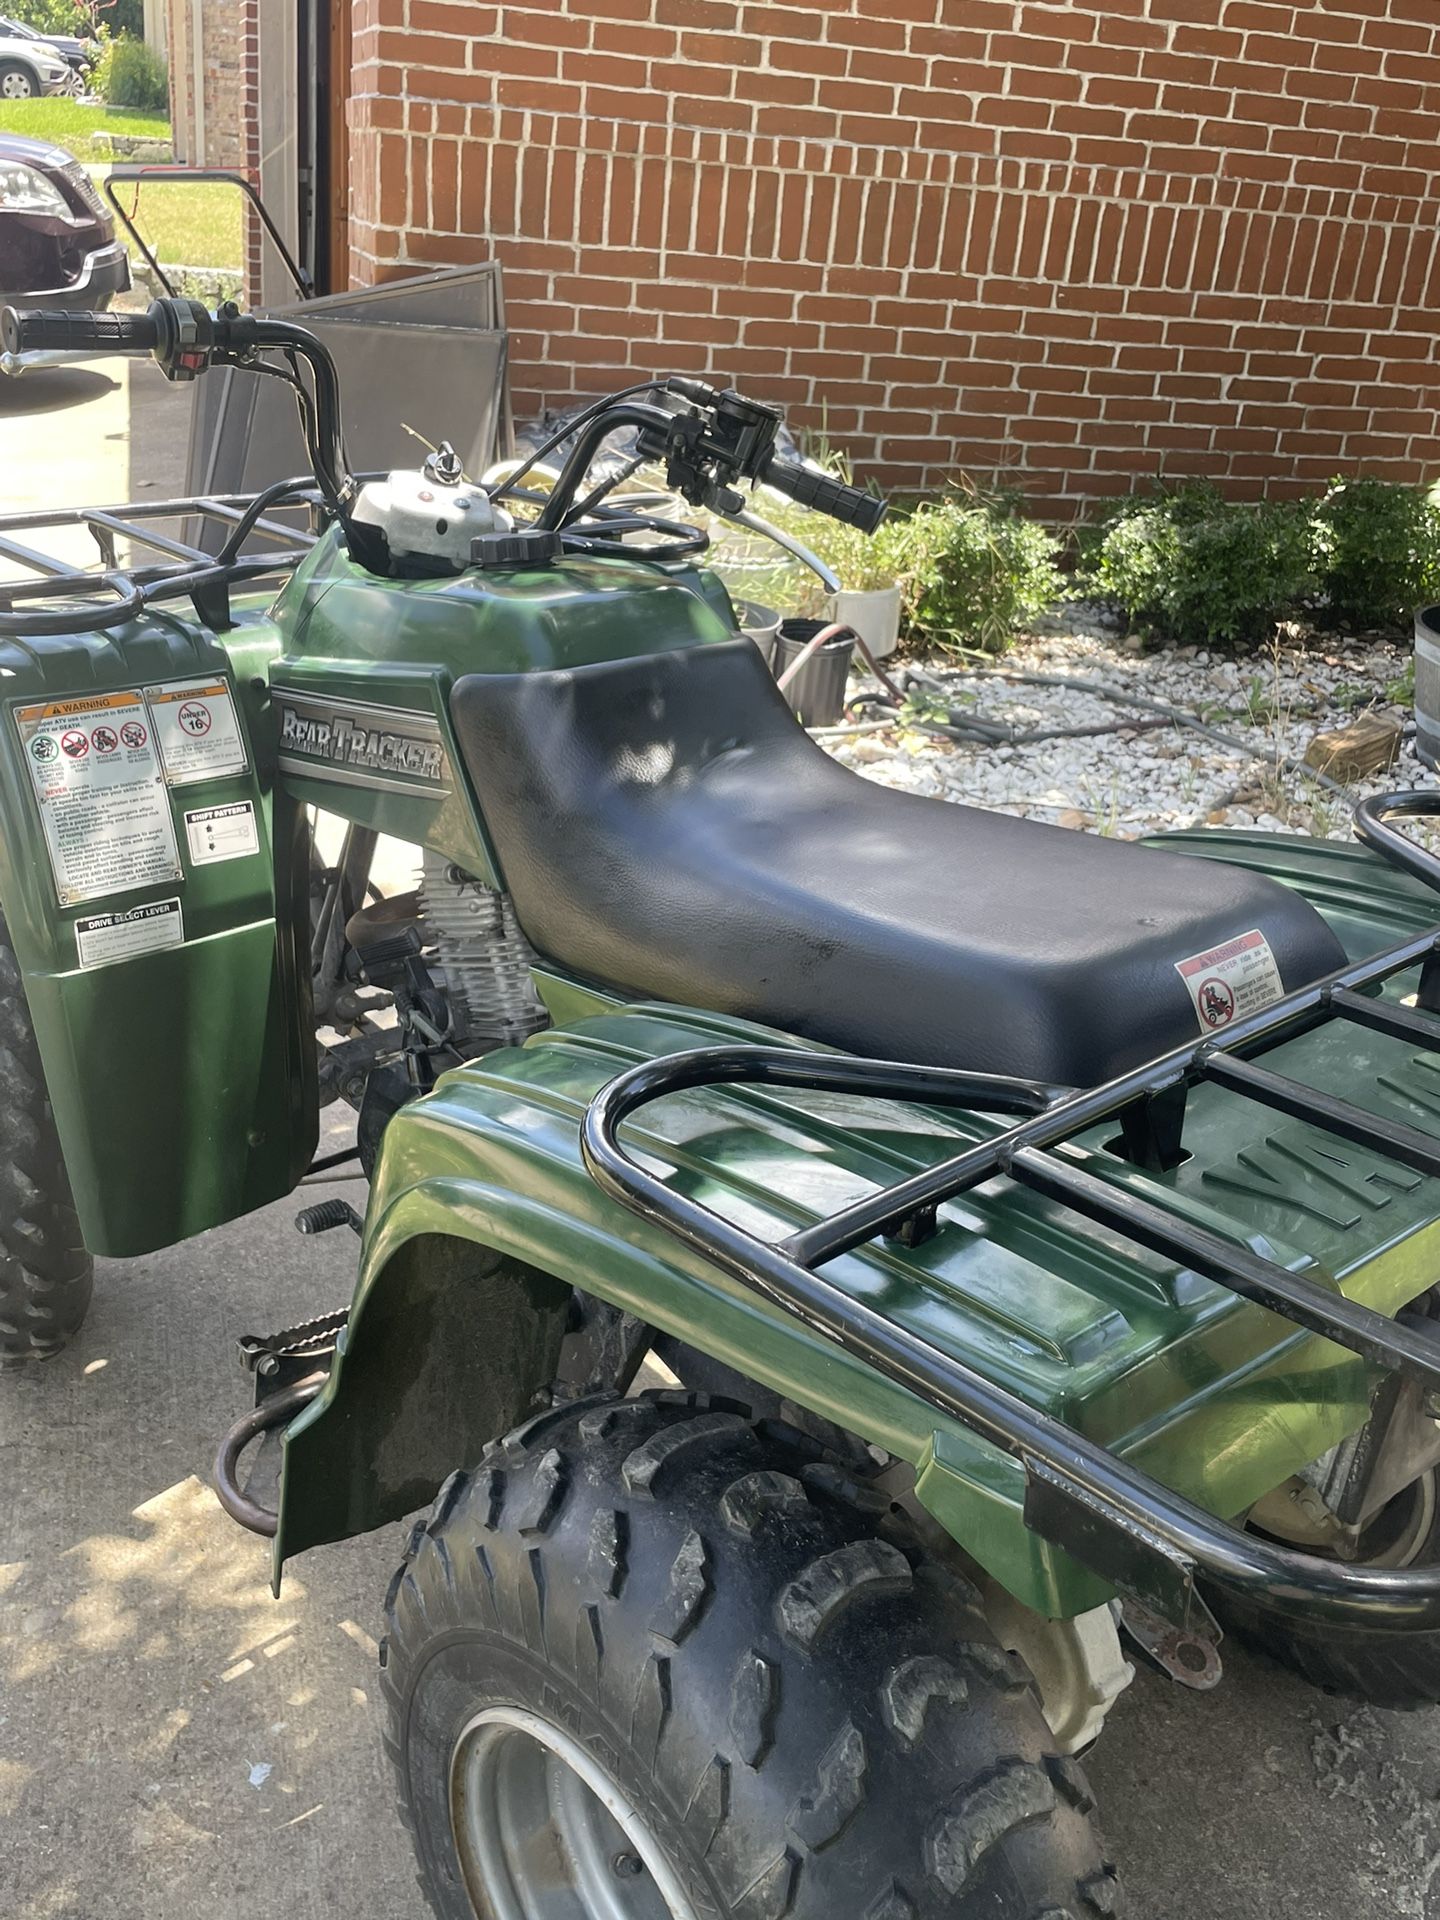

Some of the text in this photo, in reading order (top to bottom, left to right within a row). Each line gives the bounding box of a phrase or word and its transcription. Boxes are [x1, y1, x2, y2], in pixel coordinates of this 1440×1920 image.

[63, 699, 111, 713] WARNING
[181, 711, 206, 719] UNDER
[189, 719, 203, 730] 16
[45, 787, 67, 796] NEVER
[191, 806, 247, 821] SHIFT PATTERN
[88, 918, 113, 930] DRIVE
[115, 911, 145, 924] SELECT
[146, 905, 170, 916] LEVER
[1206, 940, 1247, 963] WARNING
